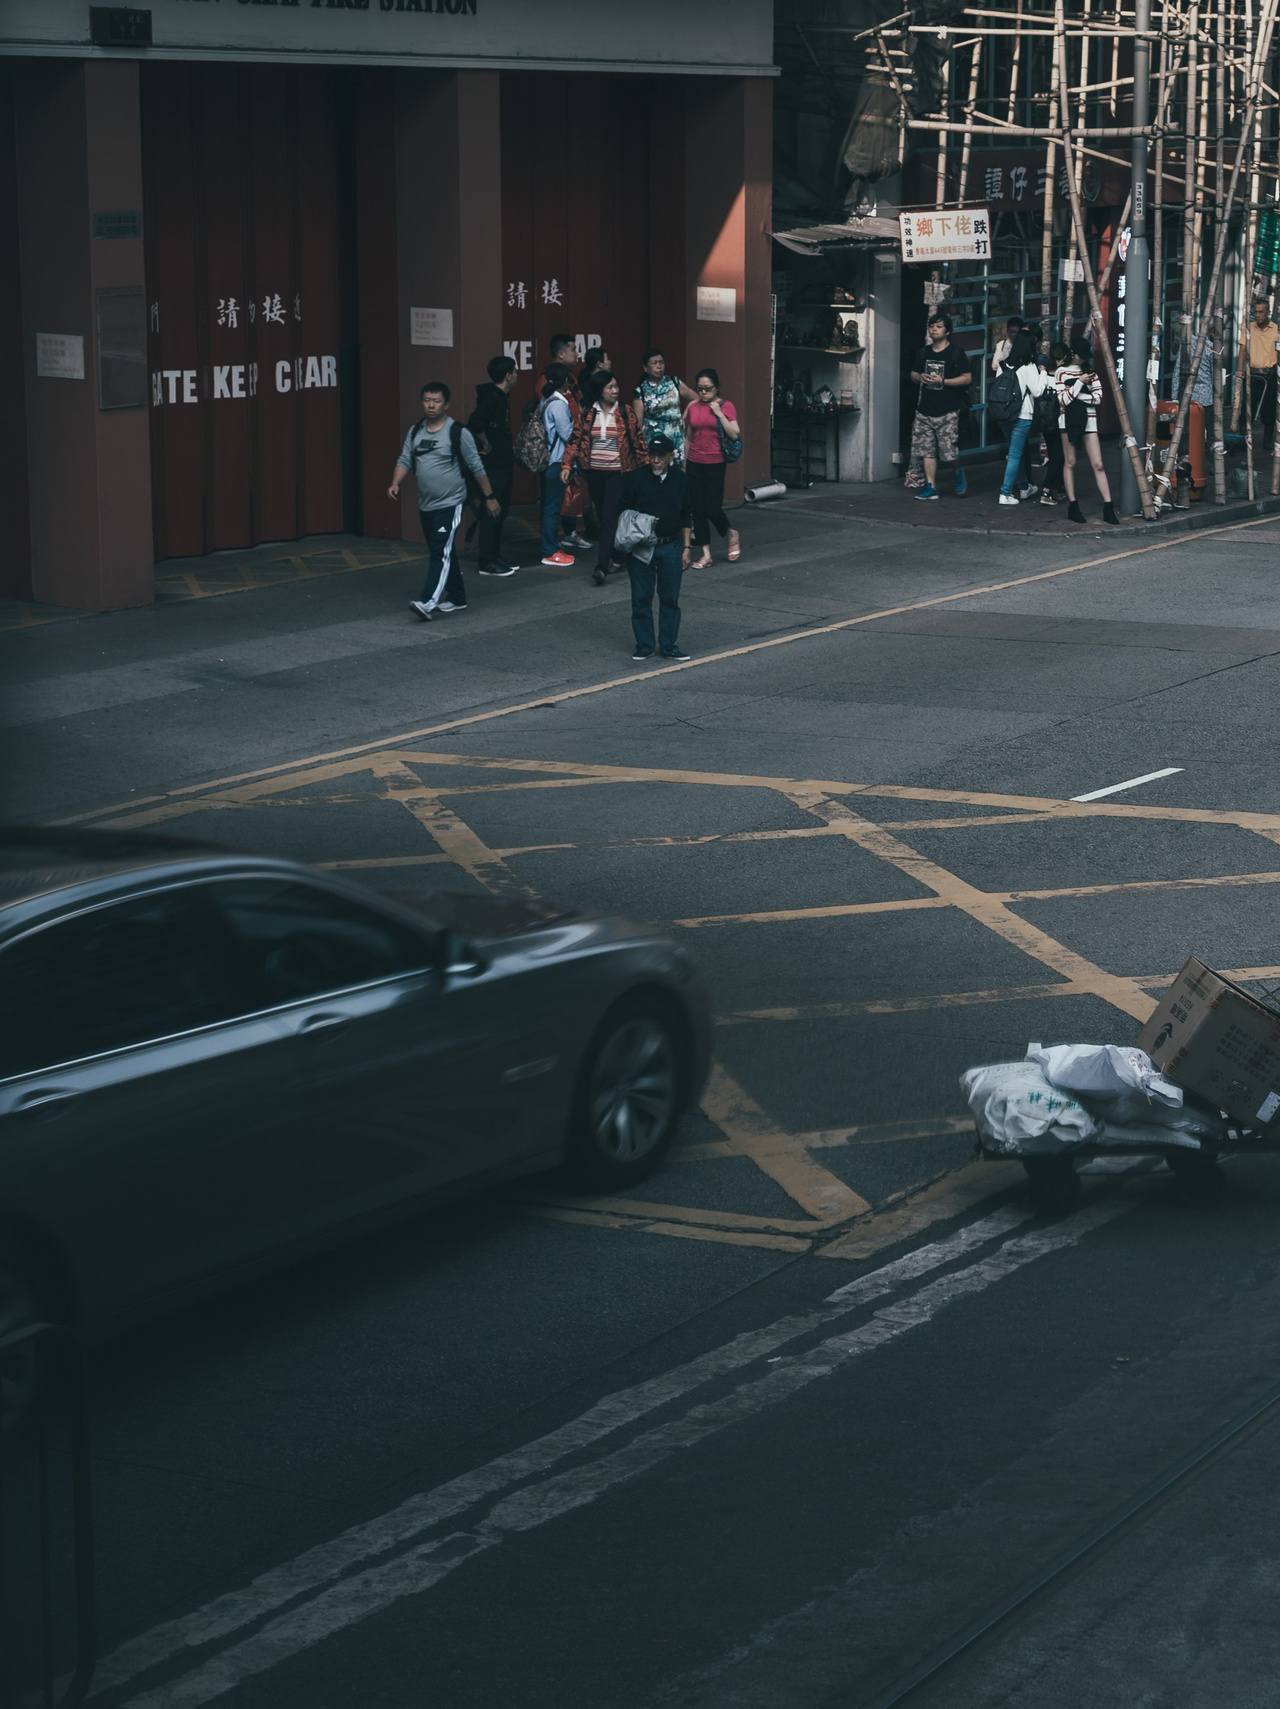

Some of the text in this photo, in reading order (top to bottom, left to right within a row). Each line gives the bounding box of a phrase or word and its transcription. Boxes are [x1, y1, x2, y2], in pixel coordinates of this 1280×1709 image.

[916, 215, 972, 237] 鄉下佬
[974, 219, 988, 254] 跌打
